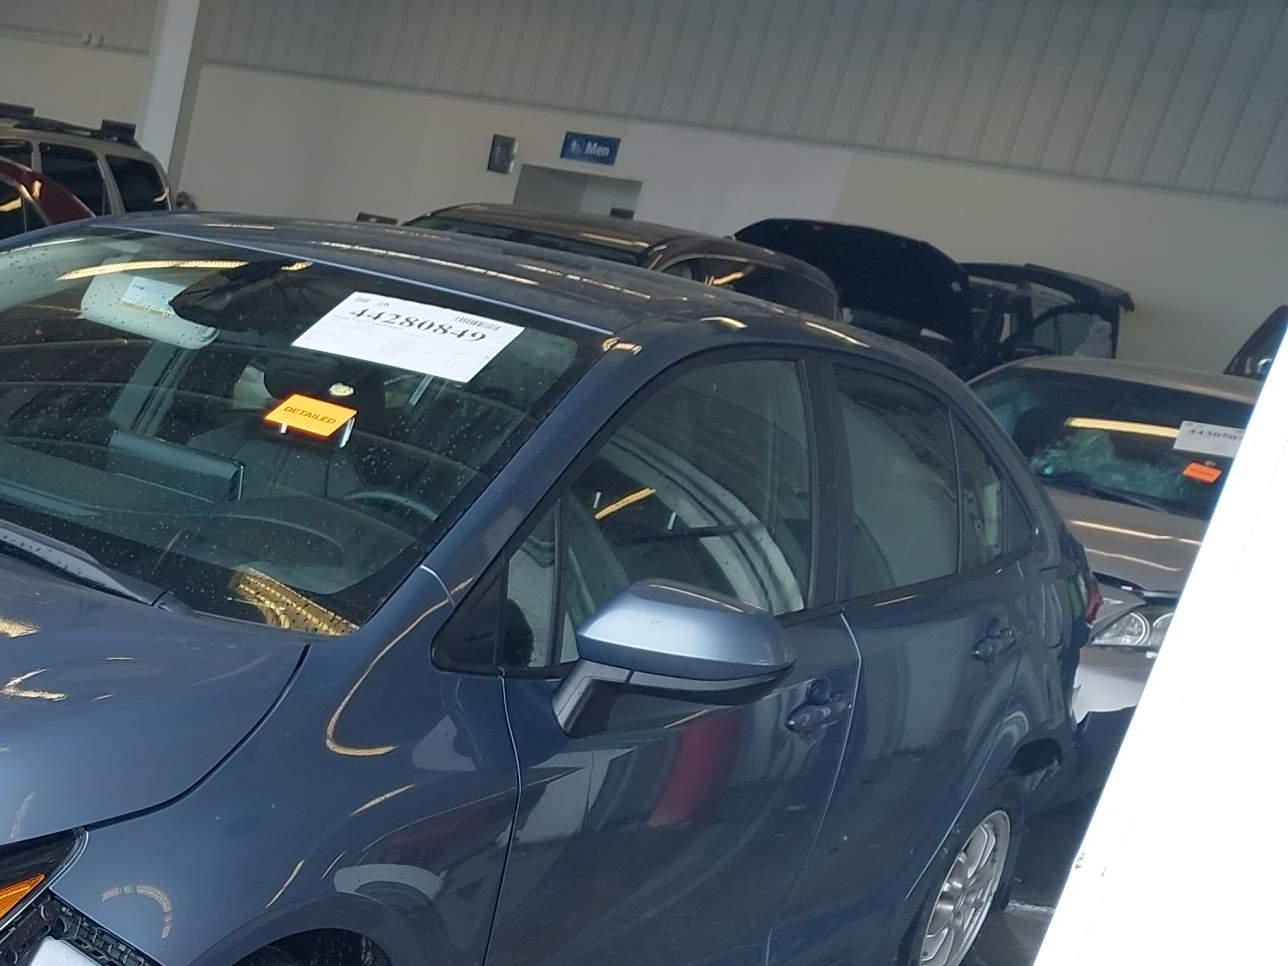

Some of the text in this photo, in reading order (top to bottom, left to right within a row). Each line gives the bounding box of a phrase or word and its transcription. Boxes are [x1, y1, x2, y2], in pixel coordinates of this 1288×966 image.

[585, 141, 610, 157] Men
[348, 307, 488, 343] 44280849
[283, 405, 337, 425] DETAILED
